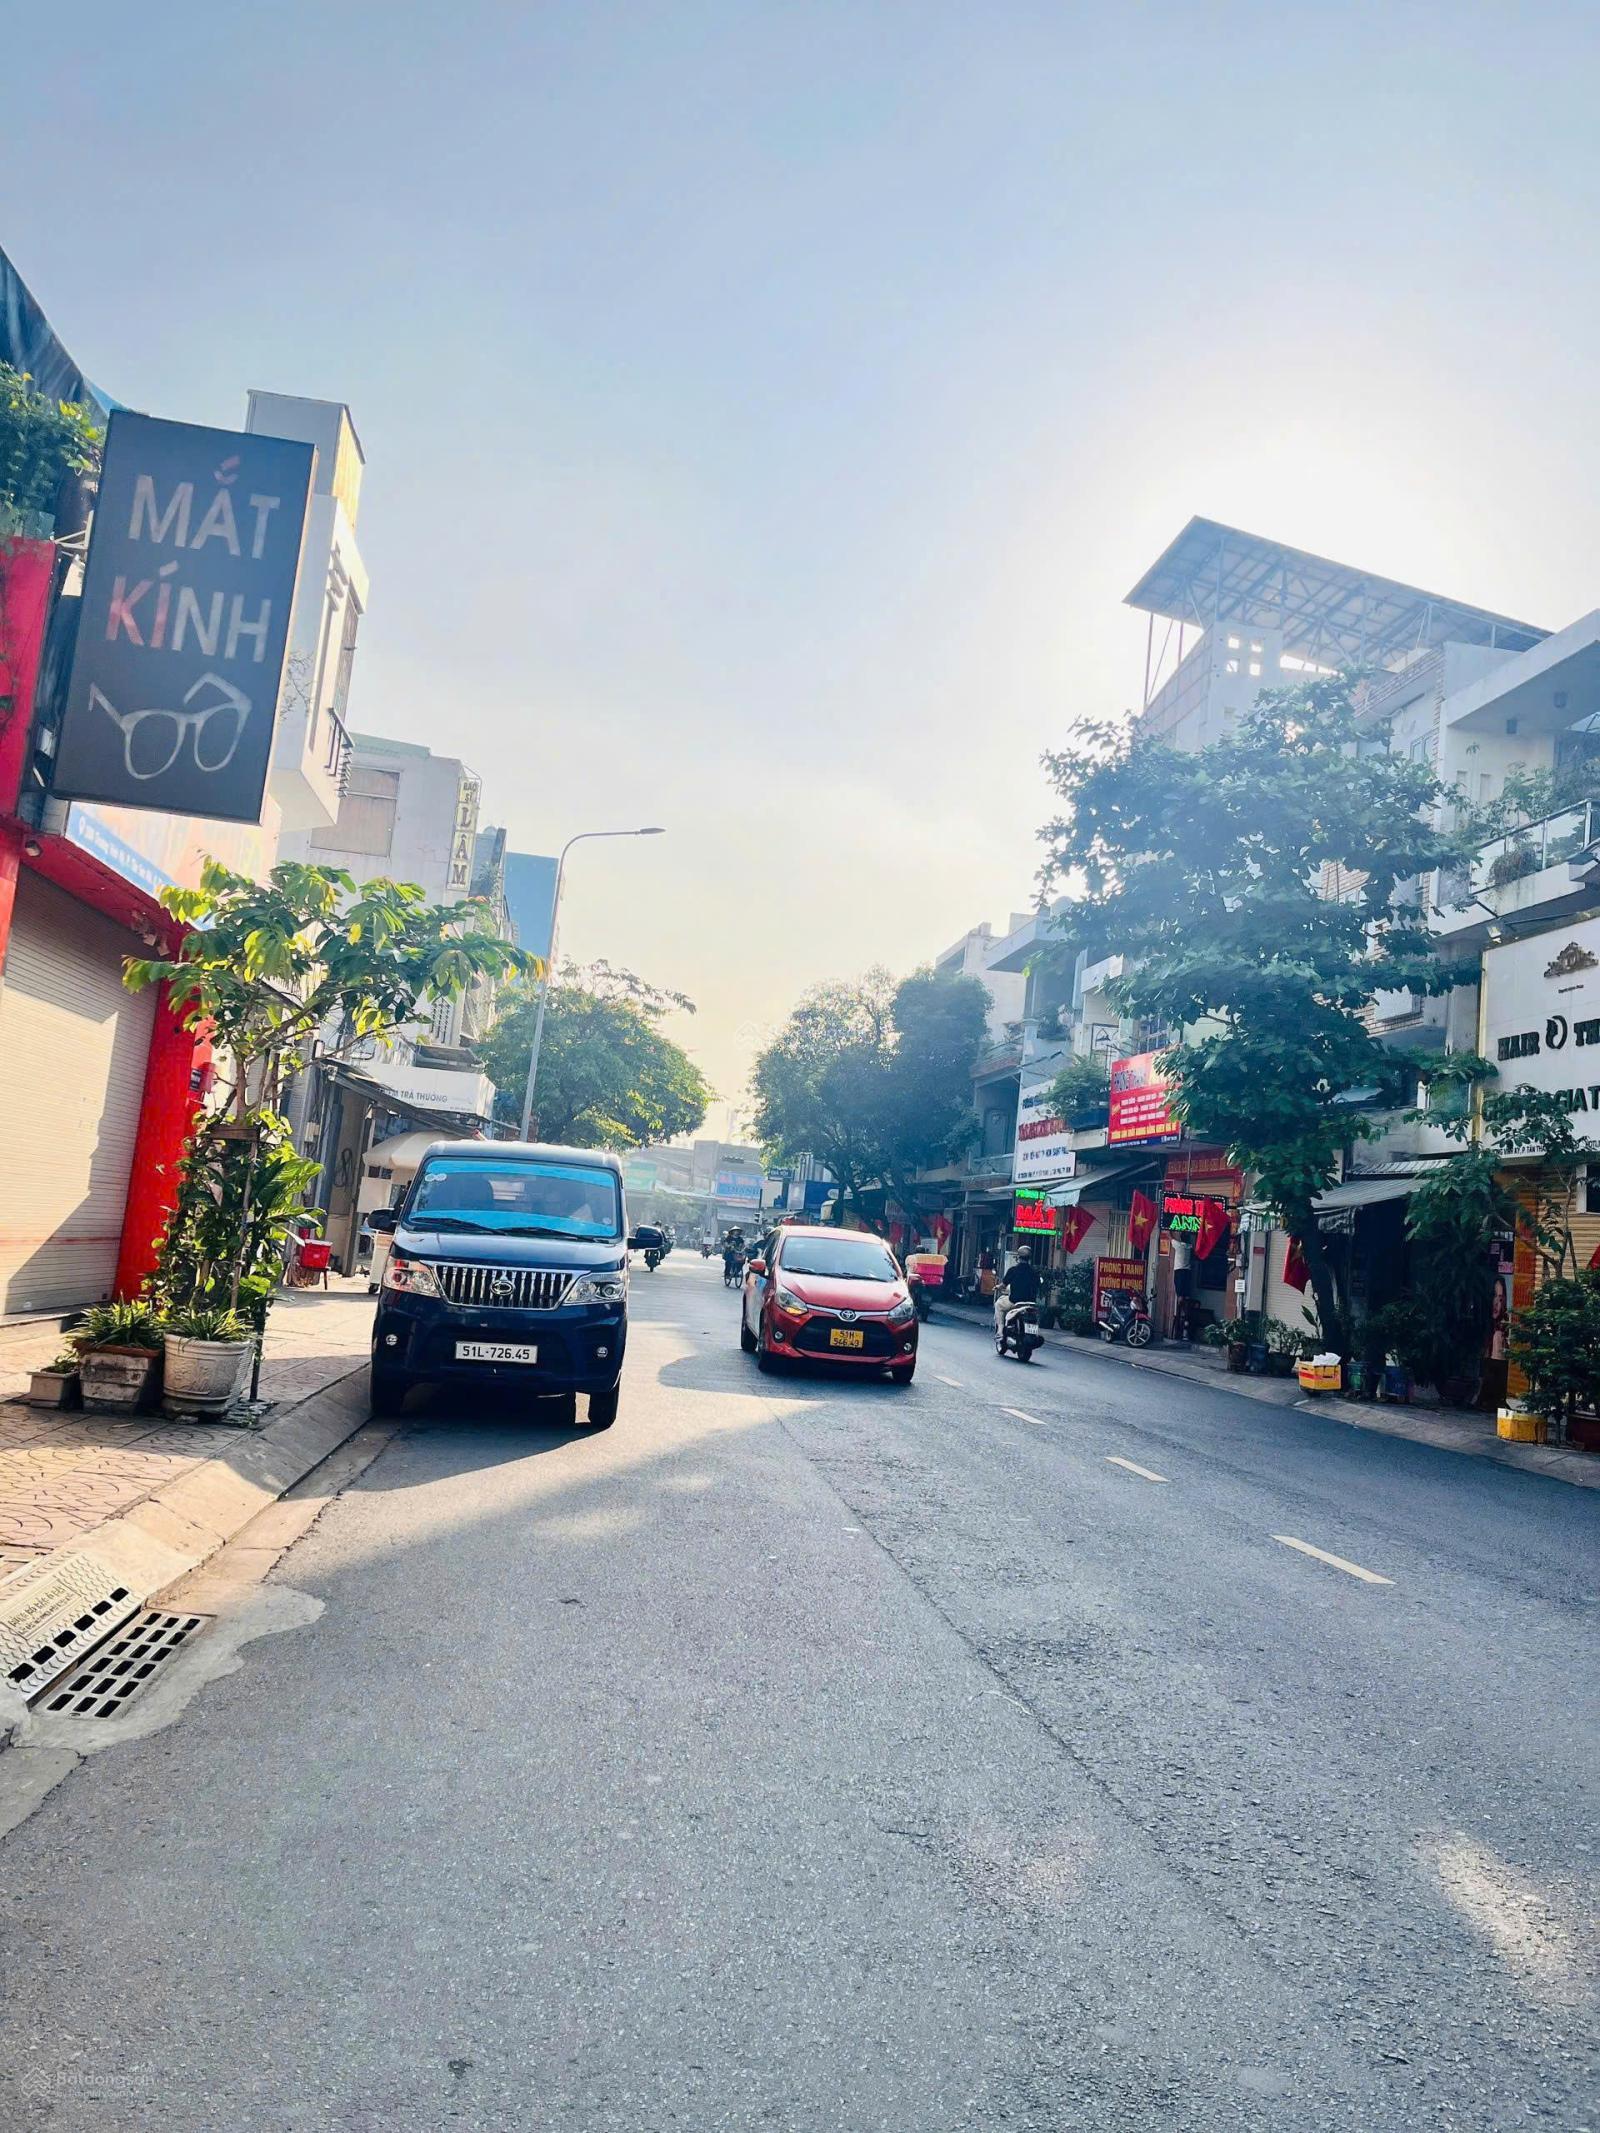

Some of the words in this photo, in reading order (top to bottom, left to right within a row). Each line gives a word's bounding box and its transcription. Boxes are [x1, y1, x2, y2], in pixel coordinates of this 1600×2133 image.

[127, 454, 281, 560] MẮT
[106, 560, 272, 663] KÍNH
[1497, 1031, 1541, 1061] HAIR
[1123, 1263, 1144, 1276] TRANH
[462, 1345, 530, 1360] 51L-726.45
